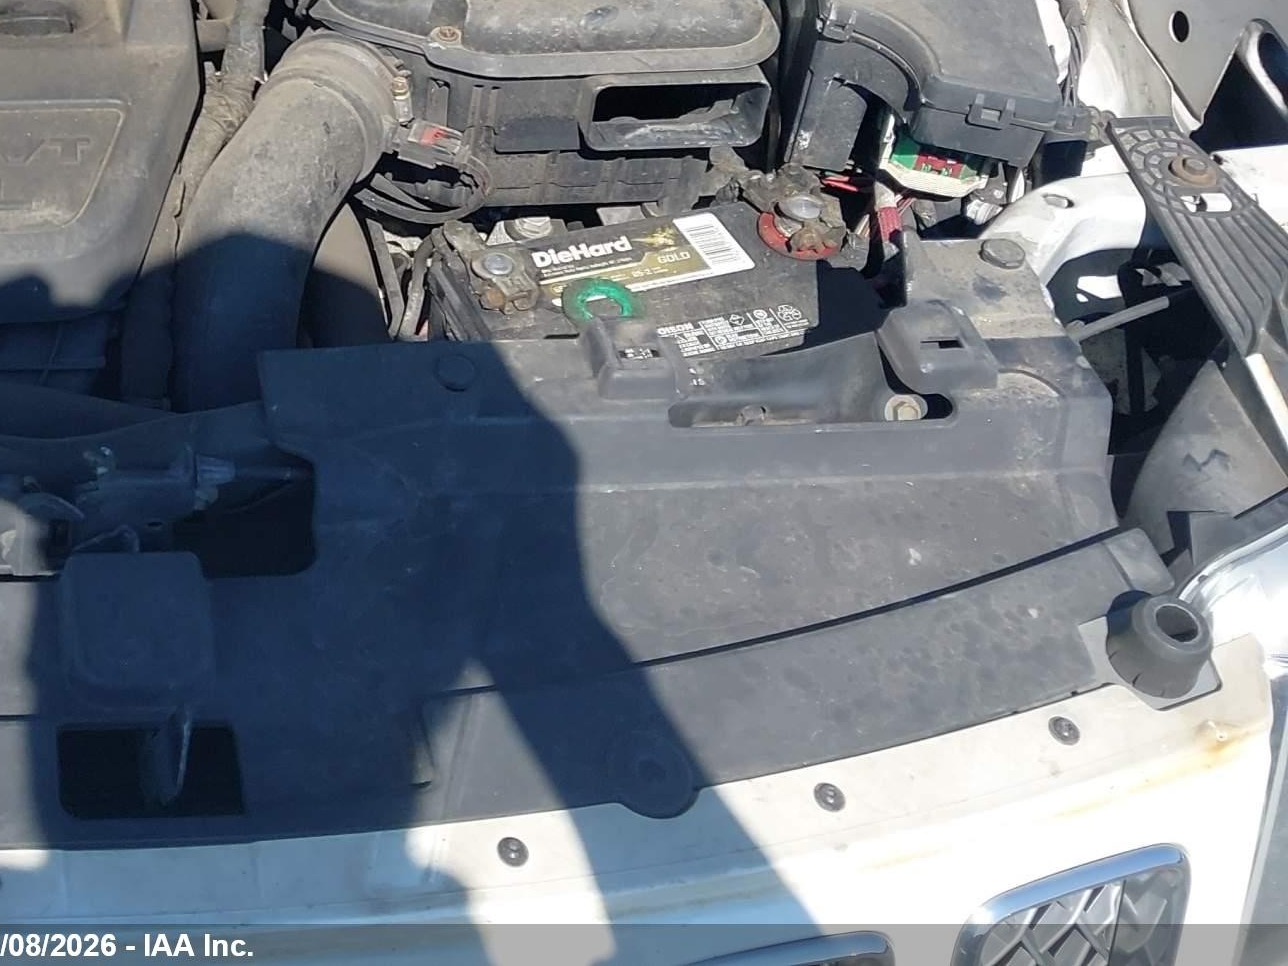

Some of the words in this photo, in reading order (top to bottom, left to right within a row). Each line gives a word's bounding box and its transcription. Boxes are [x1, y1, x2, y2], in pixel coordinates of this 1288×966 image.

[531, 235, 633, 268] DieHard
[656, 251, 691, 265] GOLD
[656, 321, 694, 335] OISON
